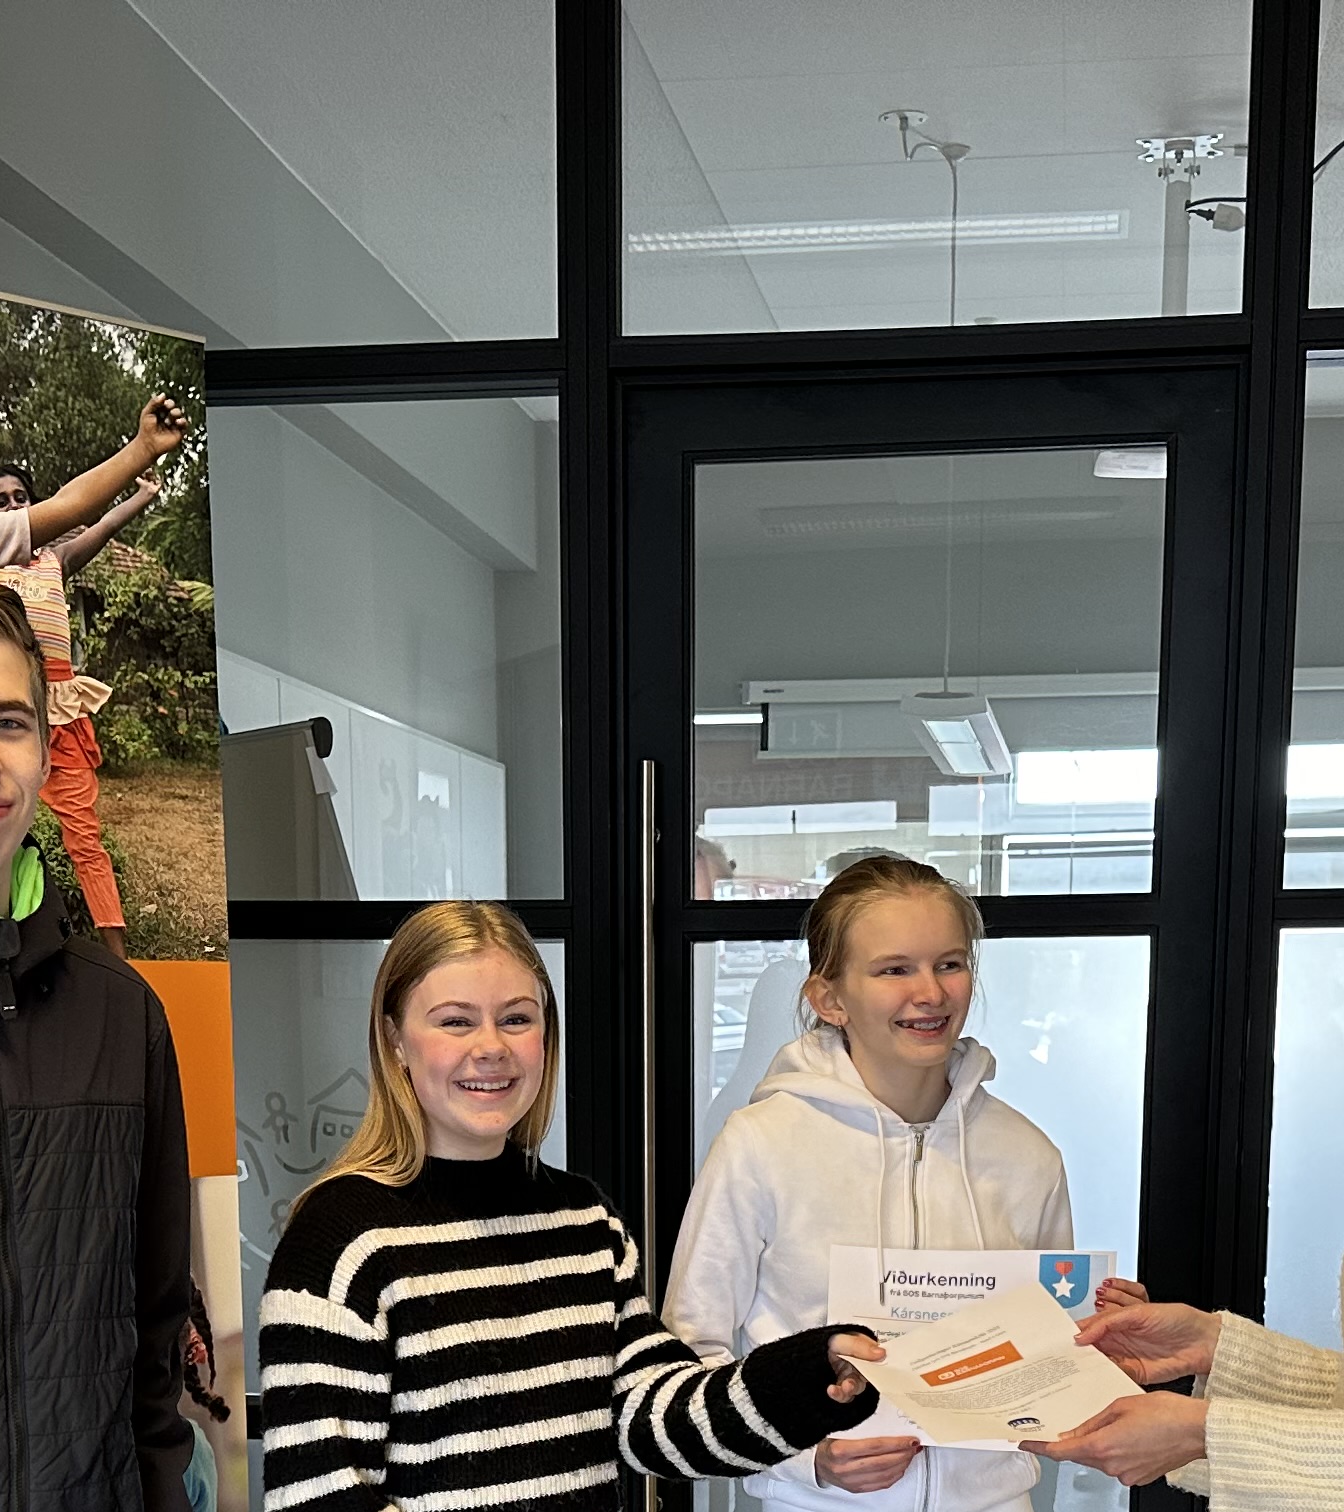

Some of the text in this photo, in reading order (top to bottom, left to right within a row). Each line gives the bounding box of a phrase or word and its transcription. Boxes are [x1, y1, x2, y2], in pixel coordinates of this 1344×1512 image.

[889, 1288, 901, 1297] frá
[902, 1289, 920, 1298] SOS
[890, 1305, 954, 1321] Kársnes
